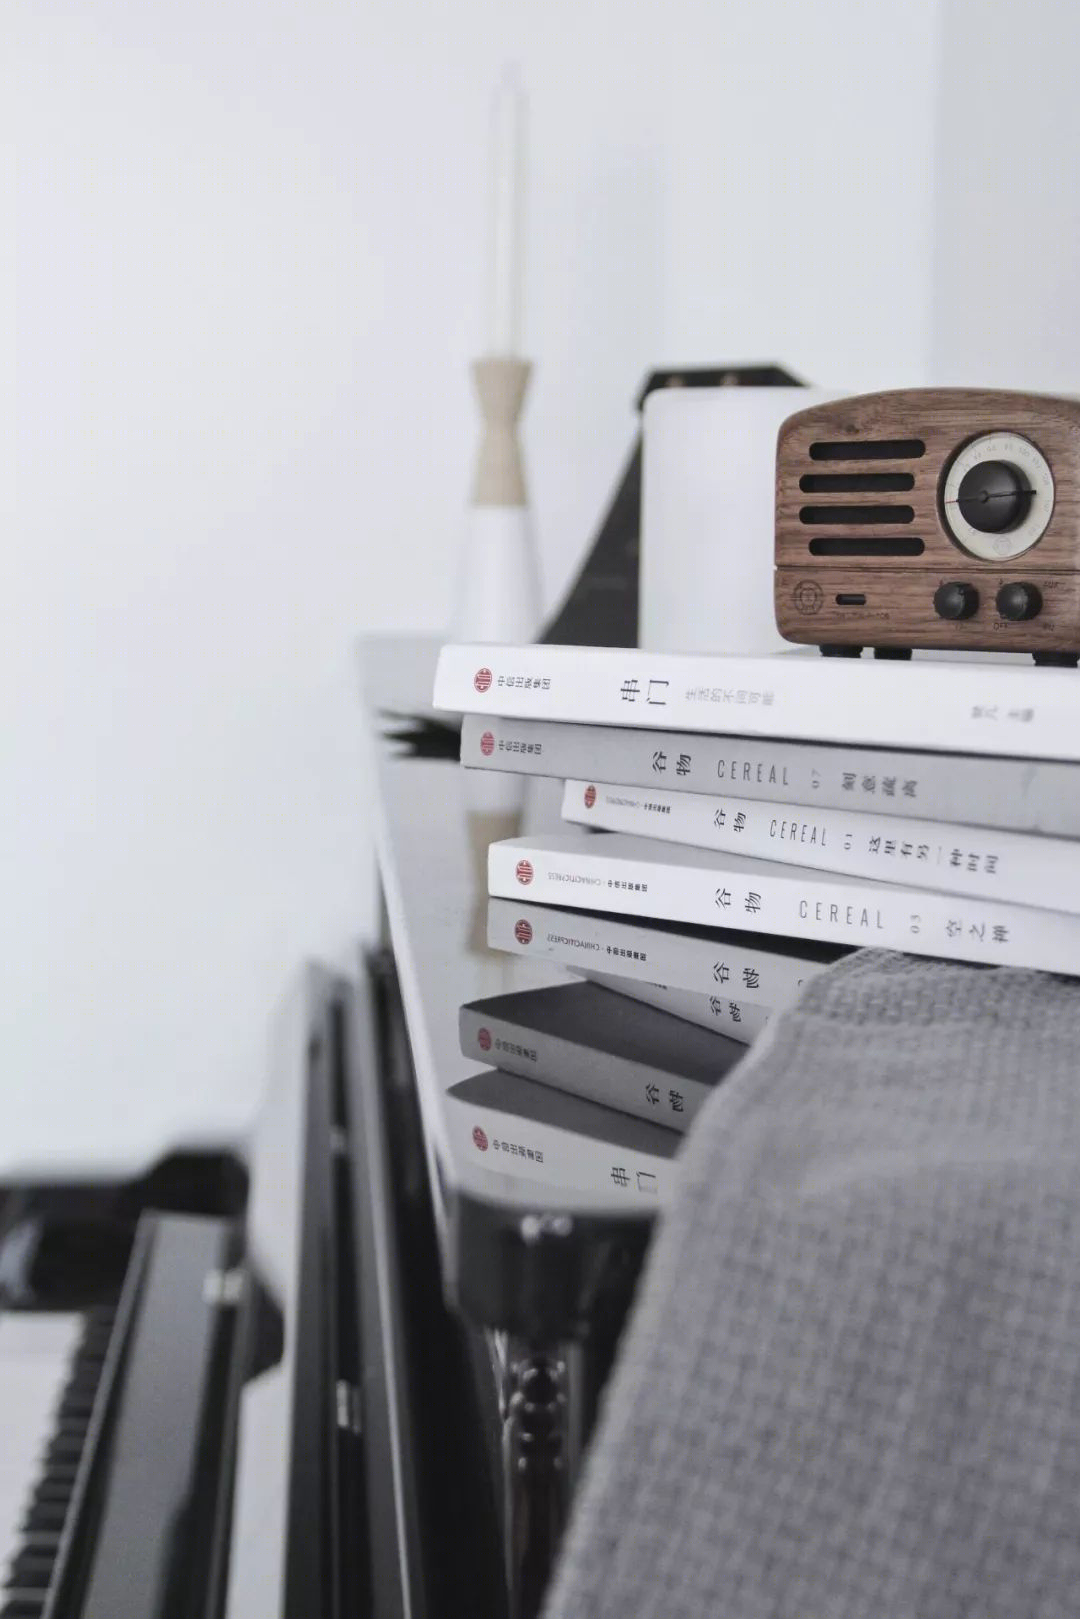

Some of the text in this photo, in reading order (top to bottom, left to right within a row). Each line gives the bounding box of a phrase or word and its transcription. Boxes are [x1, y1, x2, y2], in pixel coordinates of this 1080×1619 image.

[497, 675, 551, 690] 中信出版集团
[620, 678, 669, 705] 串门
[498, 739, 543, 756] 中信出版集团
[652, 751, 692, 776] 谷物
[717, 759, 789, 786] CEREAL
[713, 808, 747, 833] 谷物
[769, 819, 827, 847] CEREAL
[714, 887, 762, 914] 谷物
[798, 899, 884, 930] CEREAL
